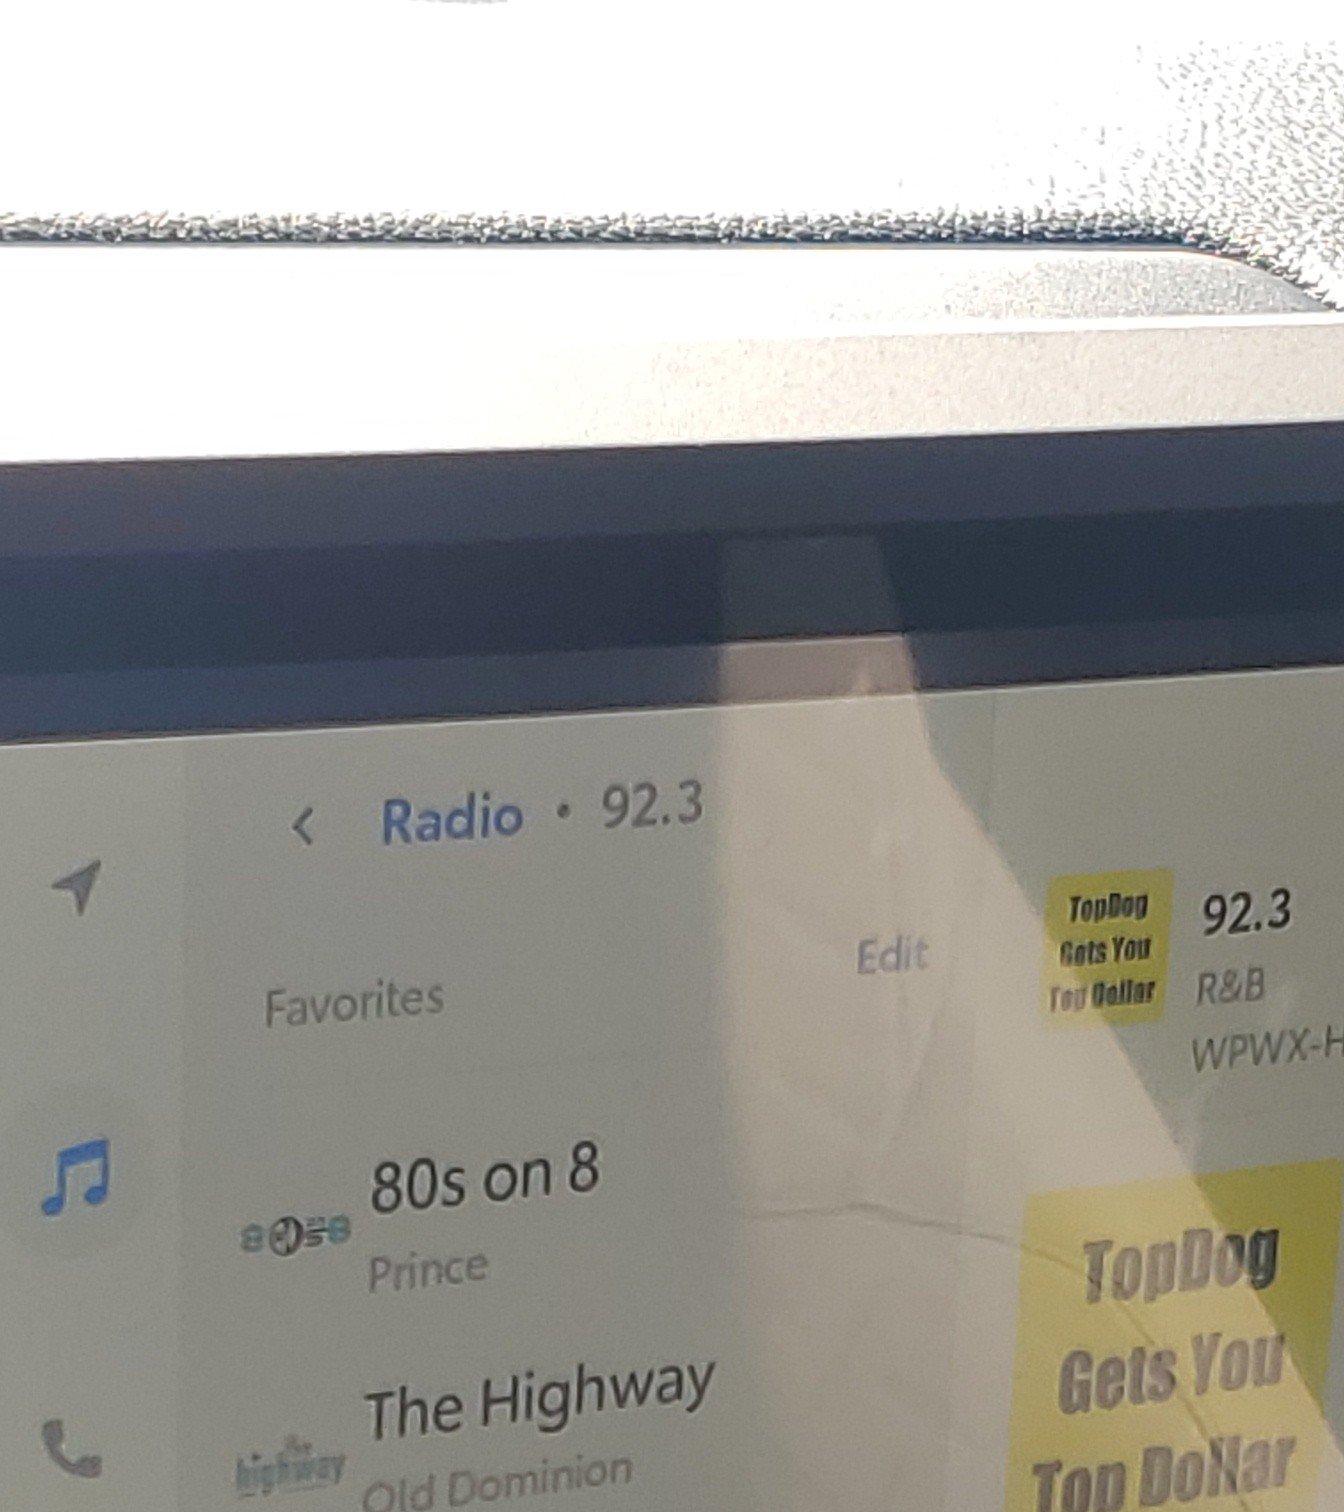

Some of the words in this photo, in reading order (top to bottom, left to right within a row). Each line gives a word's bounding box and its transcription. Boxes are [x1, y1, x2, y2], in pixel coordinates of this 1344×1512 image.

[383, 791, 524, 846] Radio
[601, 779, 704, 829] 92.3
[1068, 891, 1149, 925] TopDog
[1202, 887, 1293, 936] 92.3
[857, 933, 931, 976] Edit
[1059, 941, 1108, 967] Gets
[1111, 936, 1152, 964] You
[264, 978, 445, 1028] Favorites
[1049, 986, 1088, 1014] Top
[1090, 979, 1156, 1009] Dollar
[1196, 967, 1266, 1007] R&B
[370, 1156, 466, 1215] 80s
[483, 1155, 553, 1202] on
[569, 1139, 600, 1193] 8
[368, 1250, 490, 1294] Prince
[1083, 1227, 1280, 1304] TopDog
[1058, 1346, 1178, 1415] Gets
[1191, 1331, 1286, 1397] You
[364, 1385, 465, 1441] The
[481, 1360, 717, 1435] Highway
[448, 1453, 635, 1508] Dominion
[1138, 1435, 1297, 1508] Dollar
